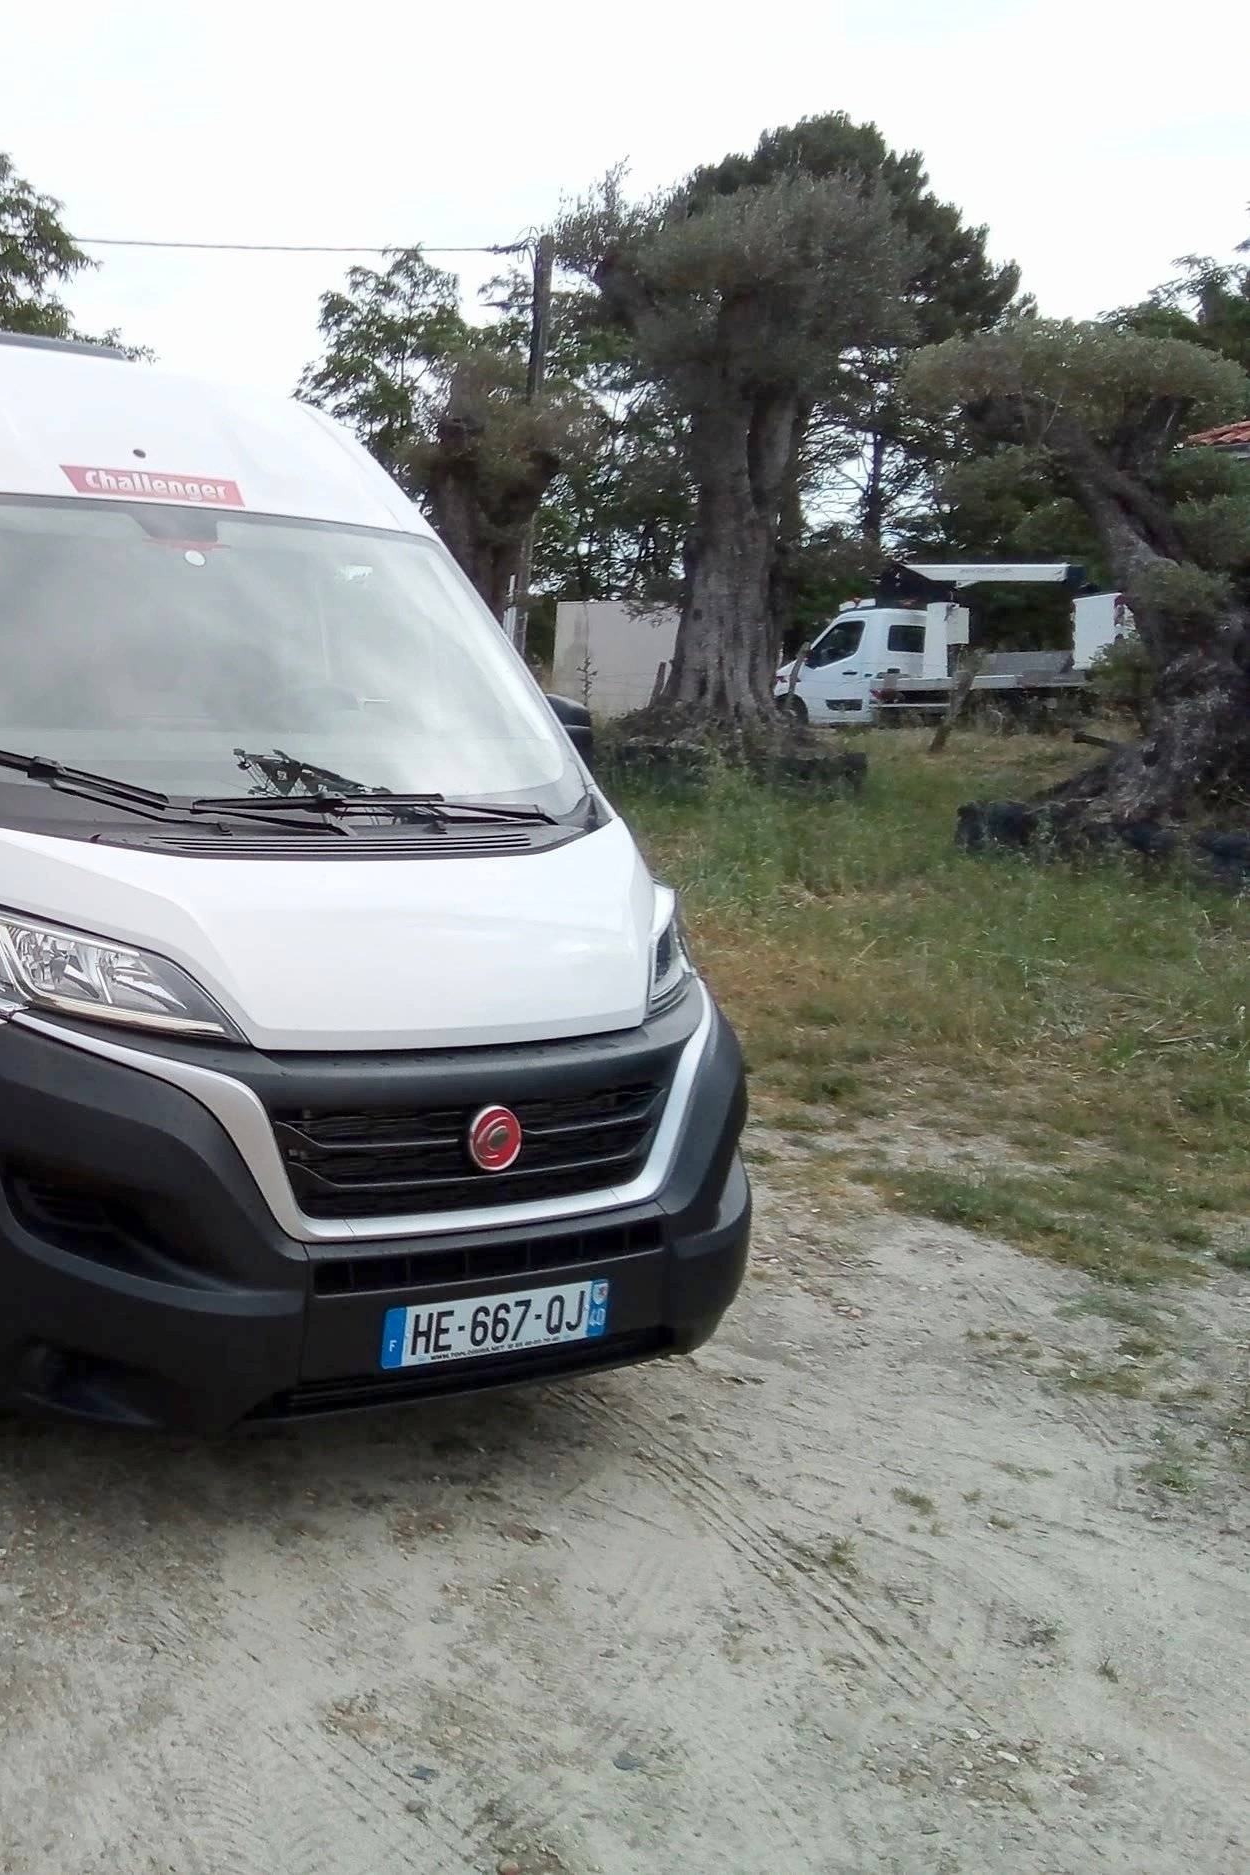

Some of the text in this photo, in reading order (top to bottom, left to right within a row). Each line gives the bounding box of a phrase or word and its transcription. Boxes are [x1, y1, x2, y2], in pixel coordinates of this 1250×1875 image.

[85, 470, 227, 501] Challenger
[410, 1290, 586, 1356] HE-667-QJ
[389, 1339, 397, 1353] F
